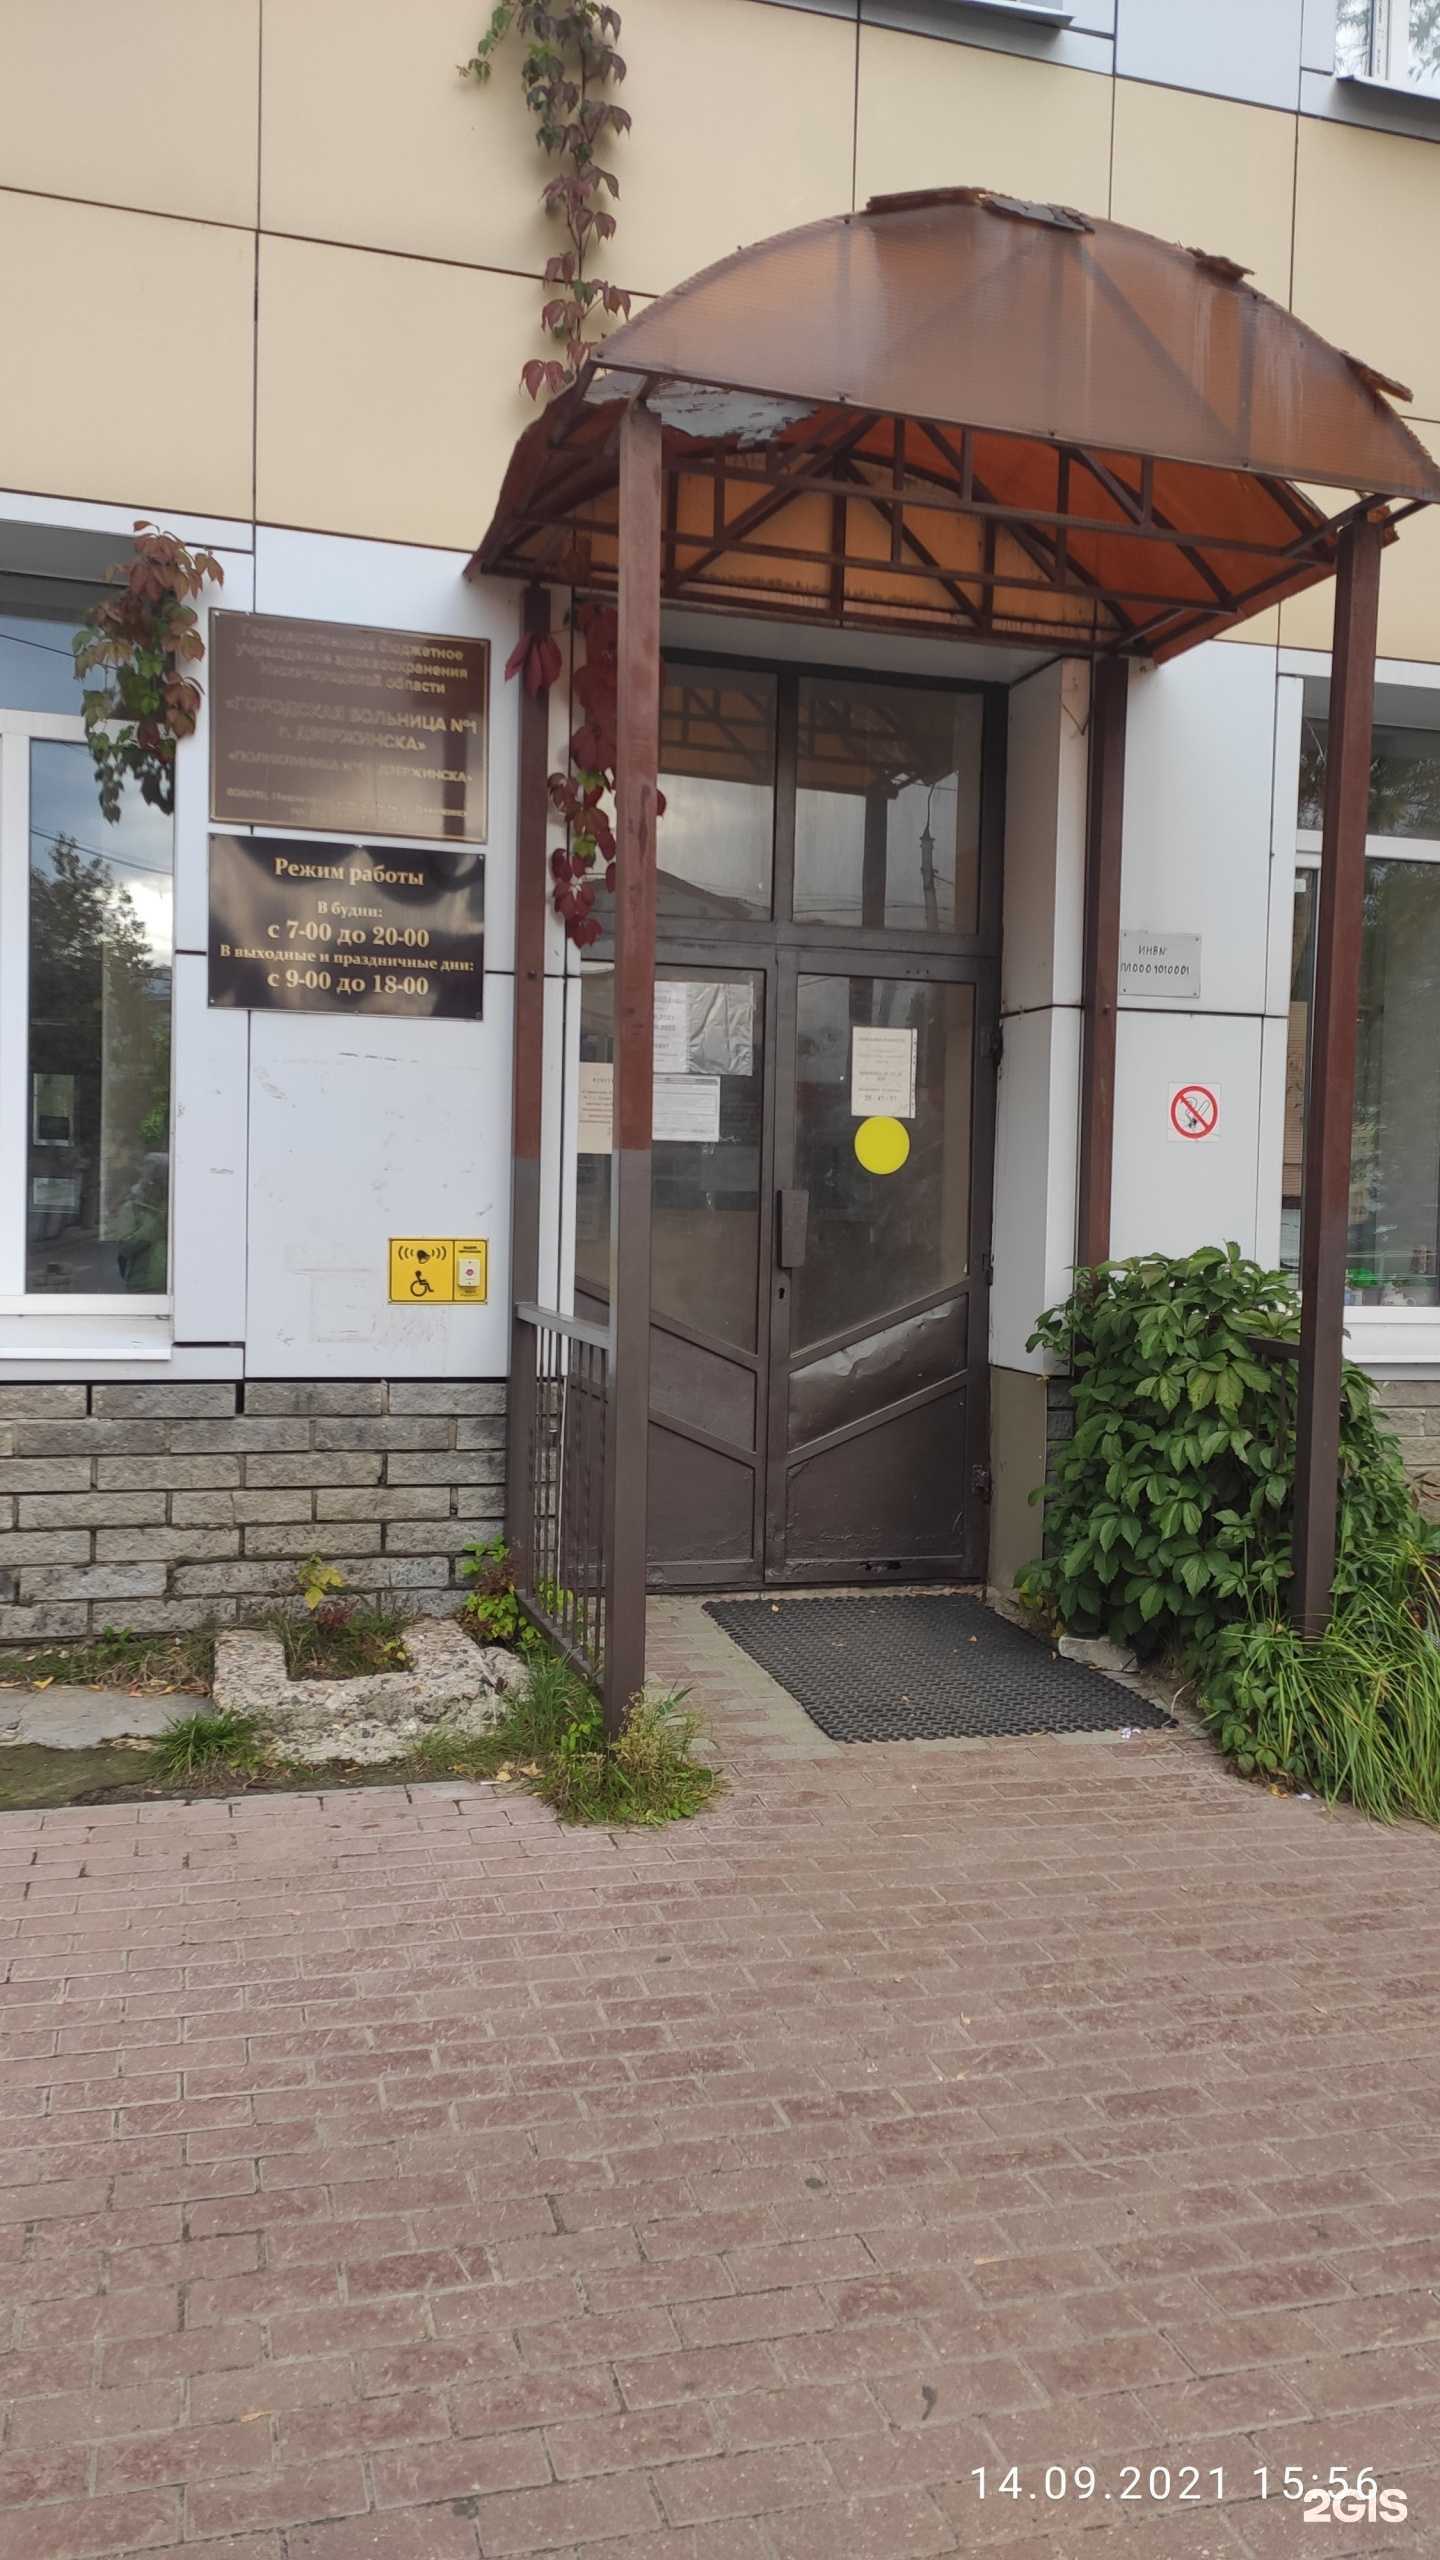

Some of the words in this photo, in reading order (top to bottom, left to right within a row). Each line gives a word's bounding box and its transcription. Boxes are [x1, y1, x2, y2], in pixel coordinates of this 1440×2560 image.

[274, 857, 344, 880] Режим
[349, 864, 424, 887] работы
[317, 901, 327, 914] В
[331, 901, 383, 918] будни:
[267, 924, 279, 938] с
[286, 921, 332, 942] 7-00
[337, 928, 366, 946] до
[372, 926, 430, 948] 20-00
[220, 944, 231, 957] В
[234, 947, 316, 963] выходные
[319, 952, 329, 963] и
[333, 953, 438, 971] праздничные
[440, 958, 474, 972] дни:
[267, 973, 279, 988] с
[286, 970, 331, 990] 9-00
[336, 976, 366, 994] до
[373, 975, 429, 996] 18-00
